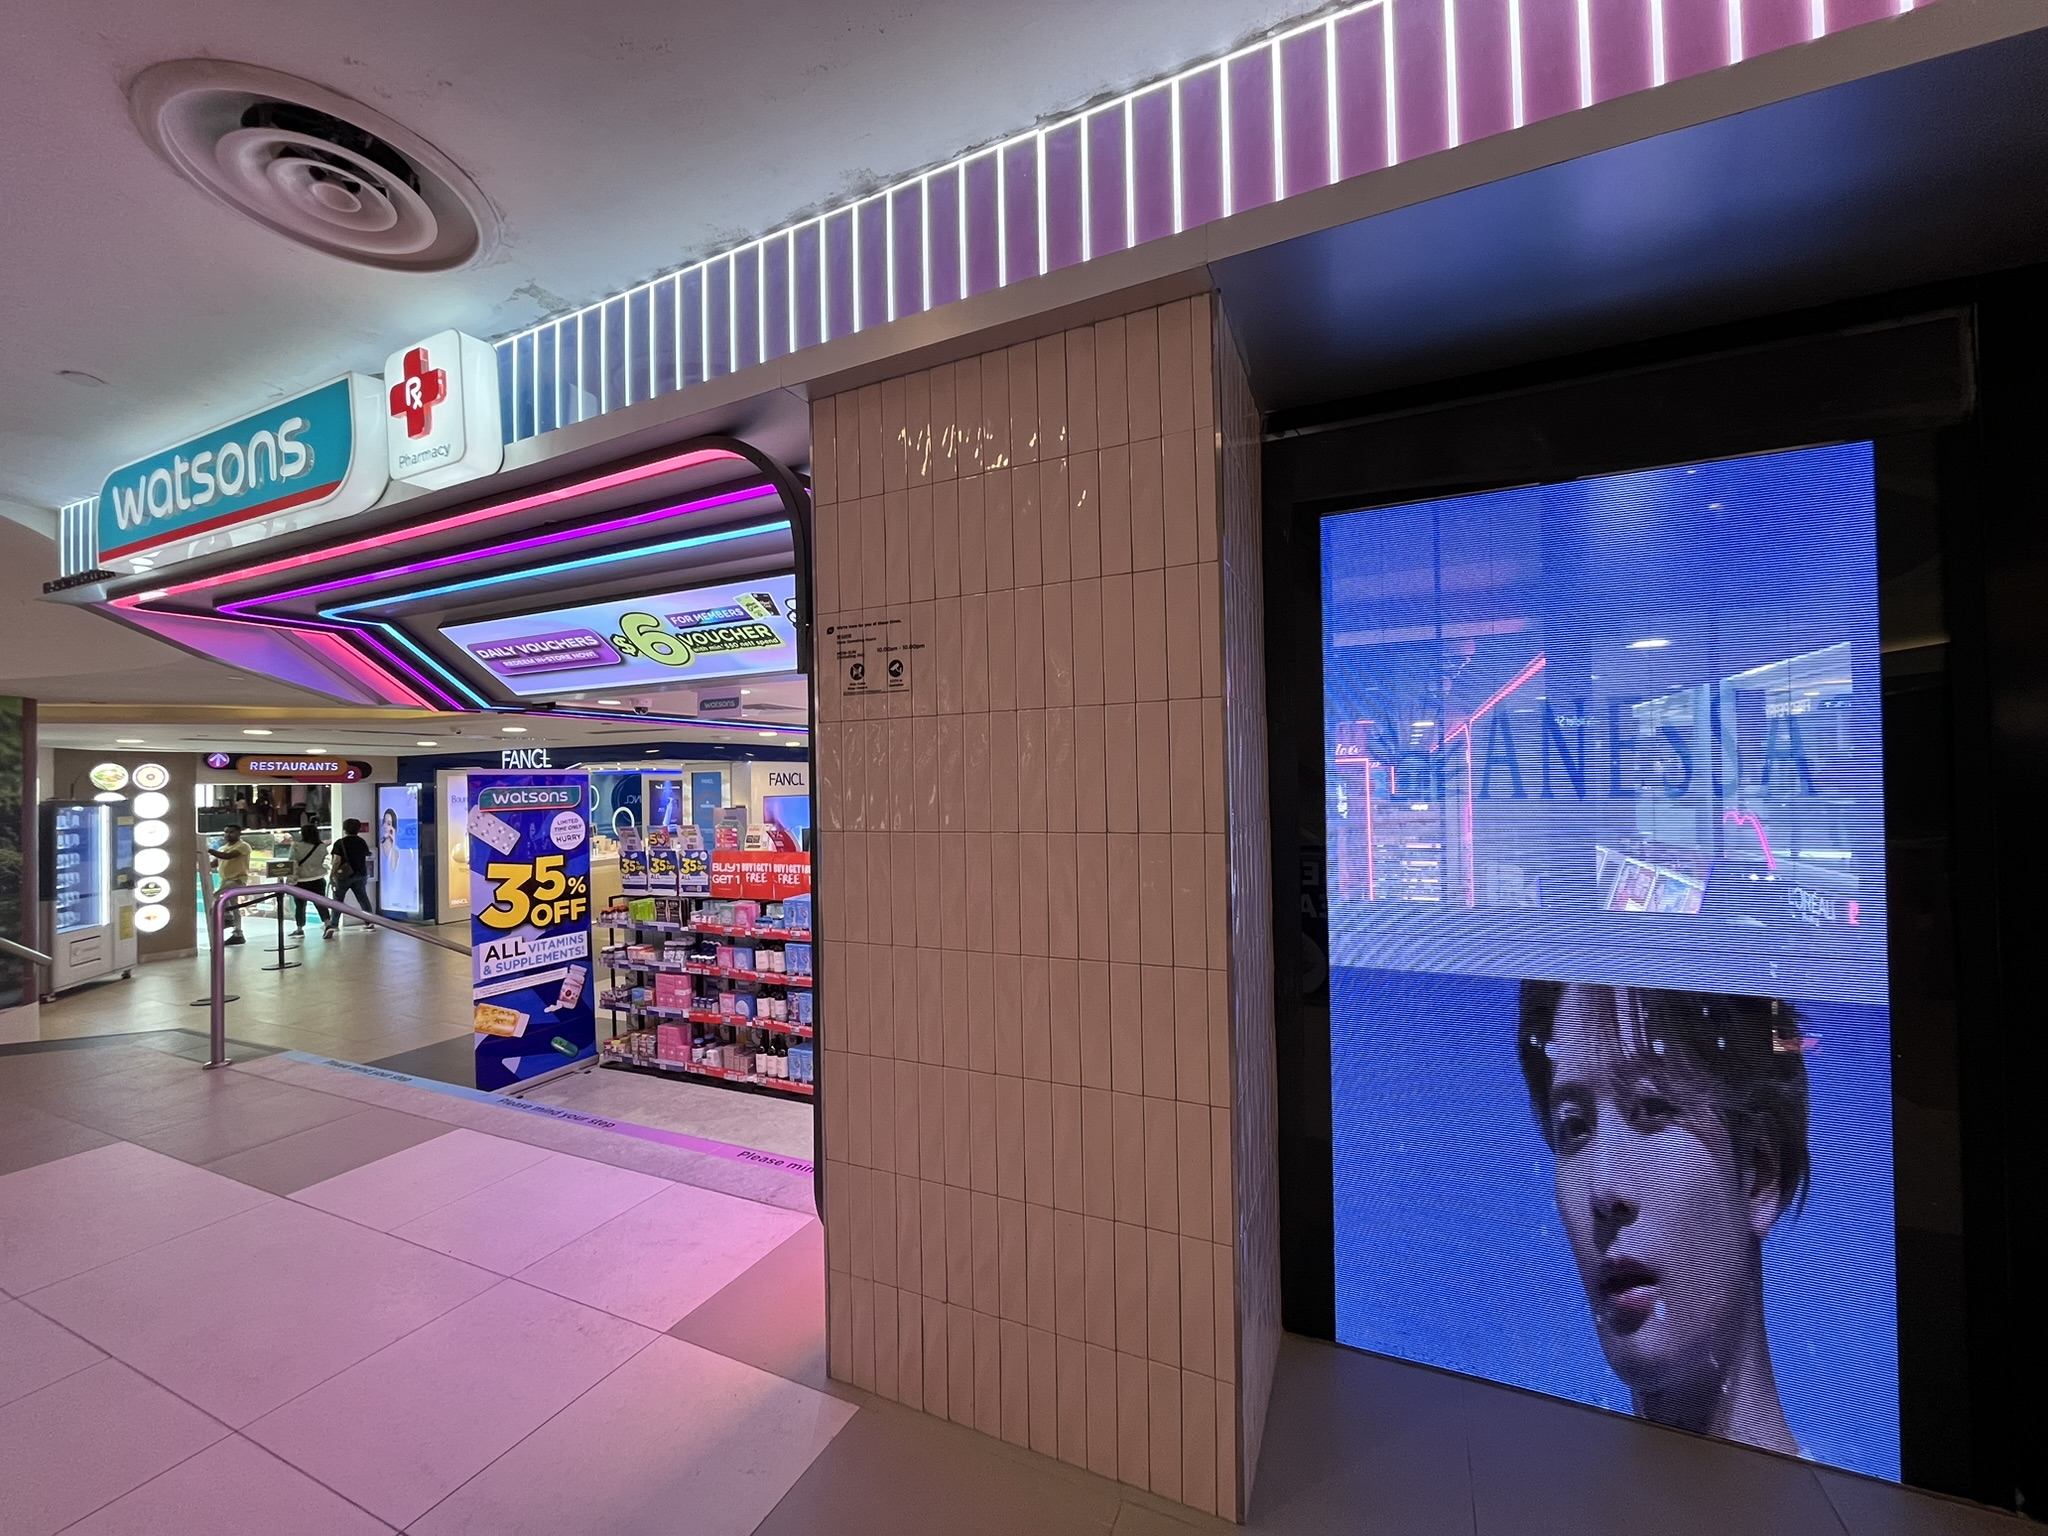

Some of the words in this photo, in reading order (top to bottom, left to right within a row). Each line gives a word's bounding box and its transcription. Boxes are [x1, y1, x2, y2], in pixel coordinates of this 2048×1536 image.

[399, 443, 451, 469] Pharmacy
[112, 417, 308, 530] watsons
[670, 615, 694, 626] FOR
[694, 608, 745, 623] MEMBERS
[677, 624, 773, 647] VOUCHER
[756, 637, 779, 646] spend
[476, 645, 517, 659] DAILY
[516, 635, 599, 654] VOUCHERS
[502, 657, 536, 668] REDEEM
[536, 653, 572, 663] IN-STORE
[572, 650, 597, 661] NOW!
[704, 700, 736, 708] watsons
[249, 761, 339, 771] RESTAURANTS
[502, 748, 553, 769] FANCL
[347, 770, 355, 779] 2
[769, 772, 805, 786] FANCL
[492, 791, 569, 805] watsons
[556, 818, 580, 826] LIMITED
[555, 833, 581, 843] HURRY
[745, 873, 768, 883] FREE
[778, 874, 801, 885] FREE
[479, 855, 587, 929] 35%
[530, 897, 587, 927] OFF
[484, 940, 526, 963] ALL
[528, 934, 584, 954] VITAMINS
[483, 966, 492, 976] &
[495, 946, 585, 973] SUPPLEMENTS!
[496, 1098, 532, 1110] Please
[530, 1105, 564, 1116] mind
[558, 1113, 589, 1122] your
[587, 1118, 616, 1129] step
[736, 1150, 785, 1166] Please
[786, 1162, 815, 1173] min
